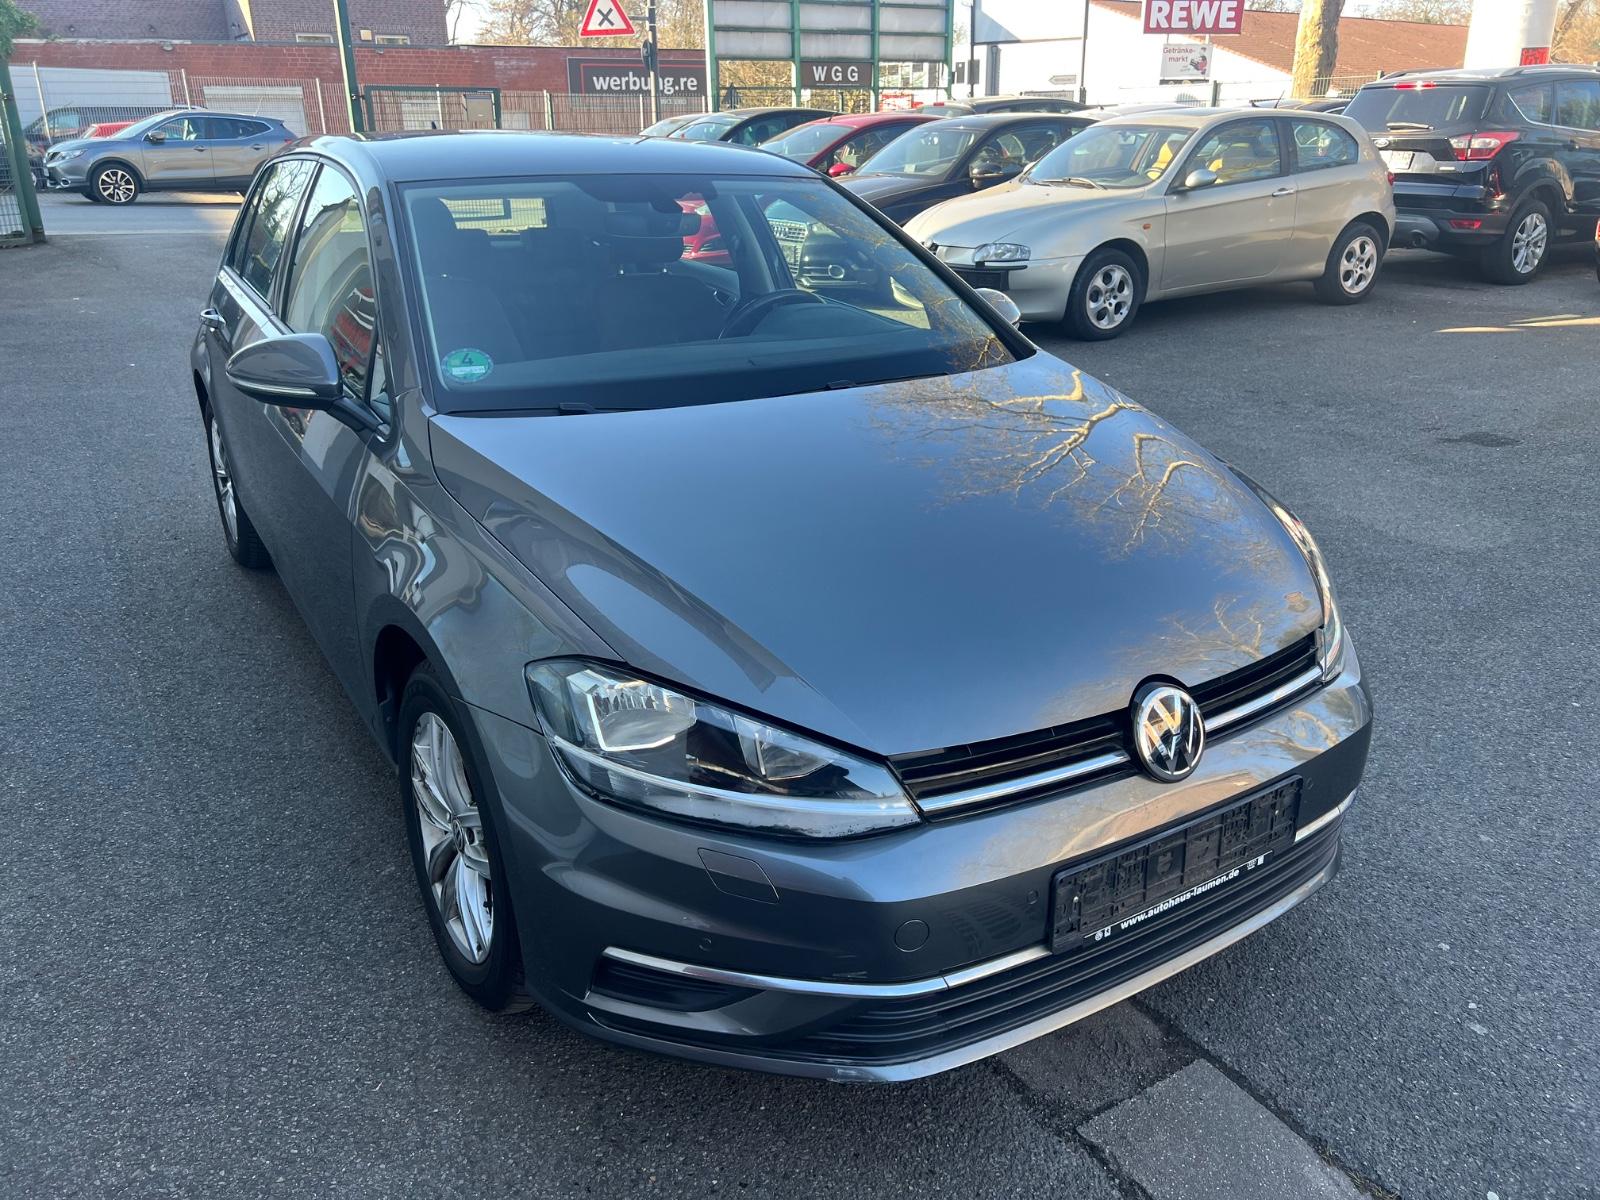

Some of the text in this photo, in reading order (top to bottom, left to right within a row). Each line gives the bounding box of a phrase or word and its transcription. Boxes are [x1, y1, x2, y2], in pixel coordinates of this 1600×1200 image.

[1149, 0, 1238, 30] REWE
[461, 352, 474, 365] 4
[1120, 868, 1240, 930] www.autohaus-laumen.de
